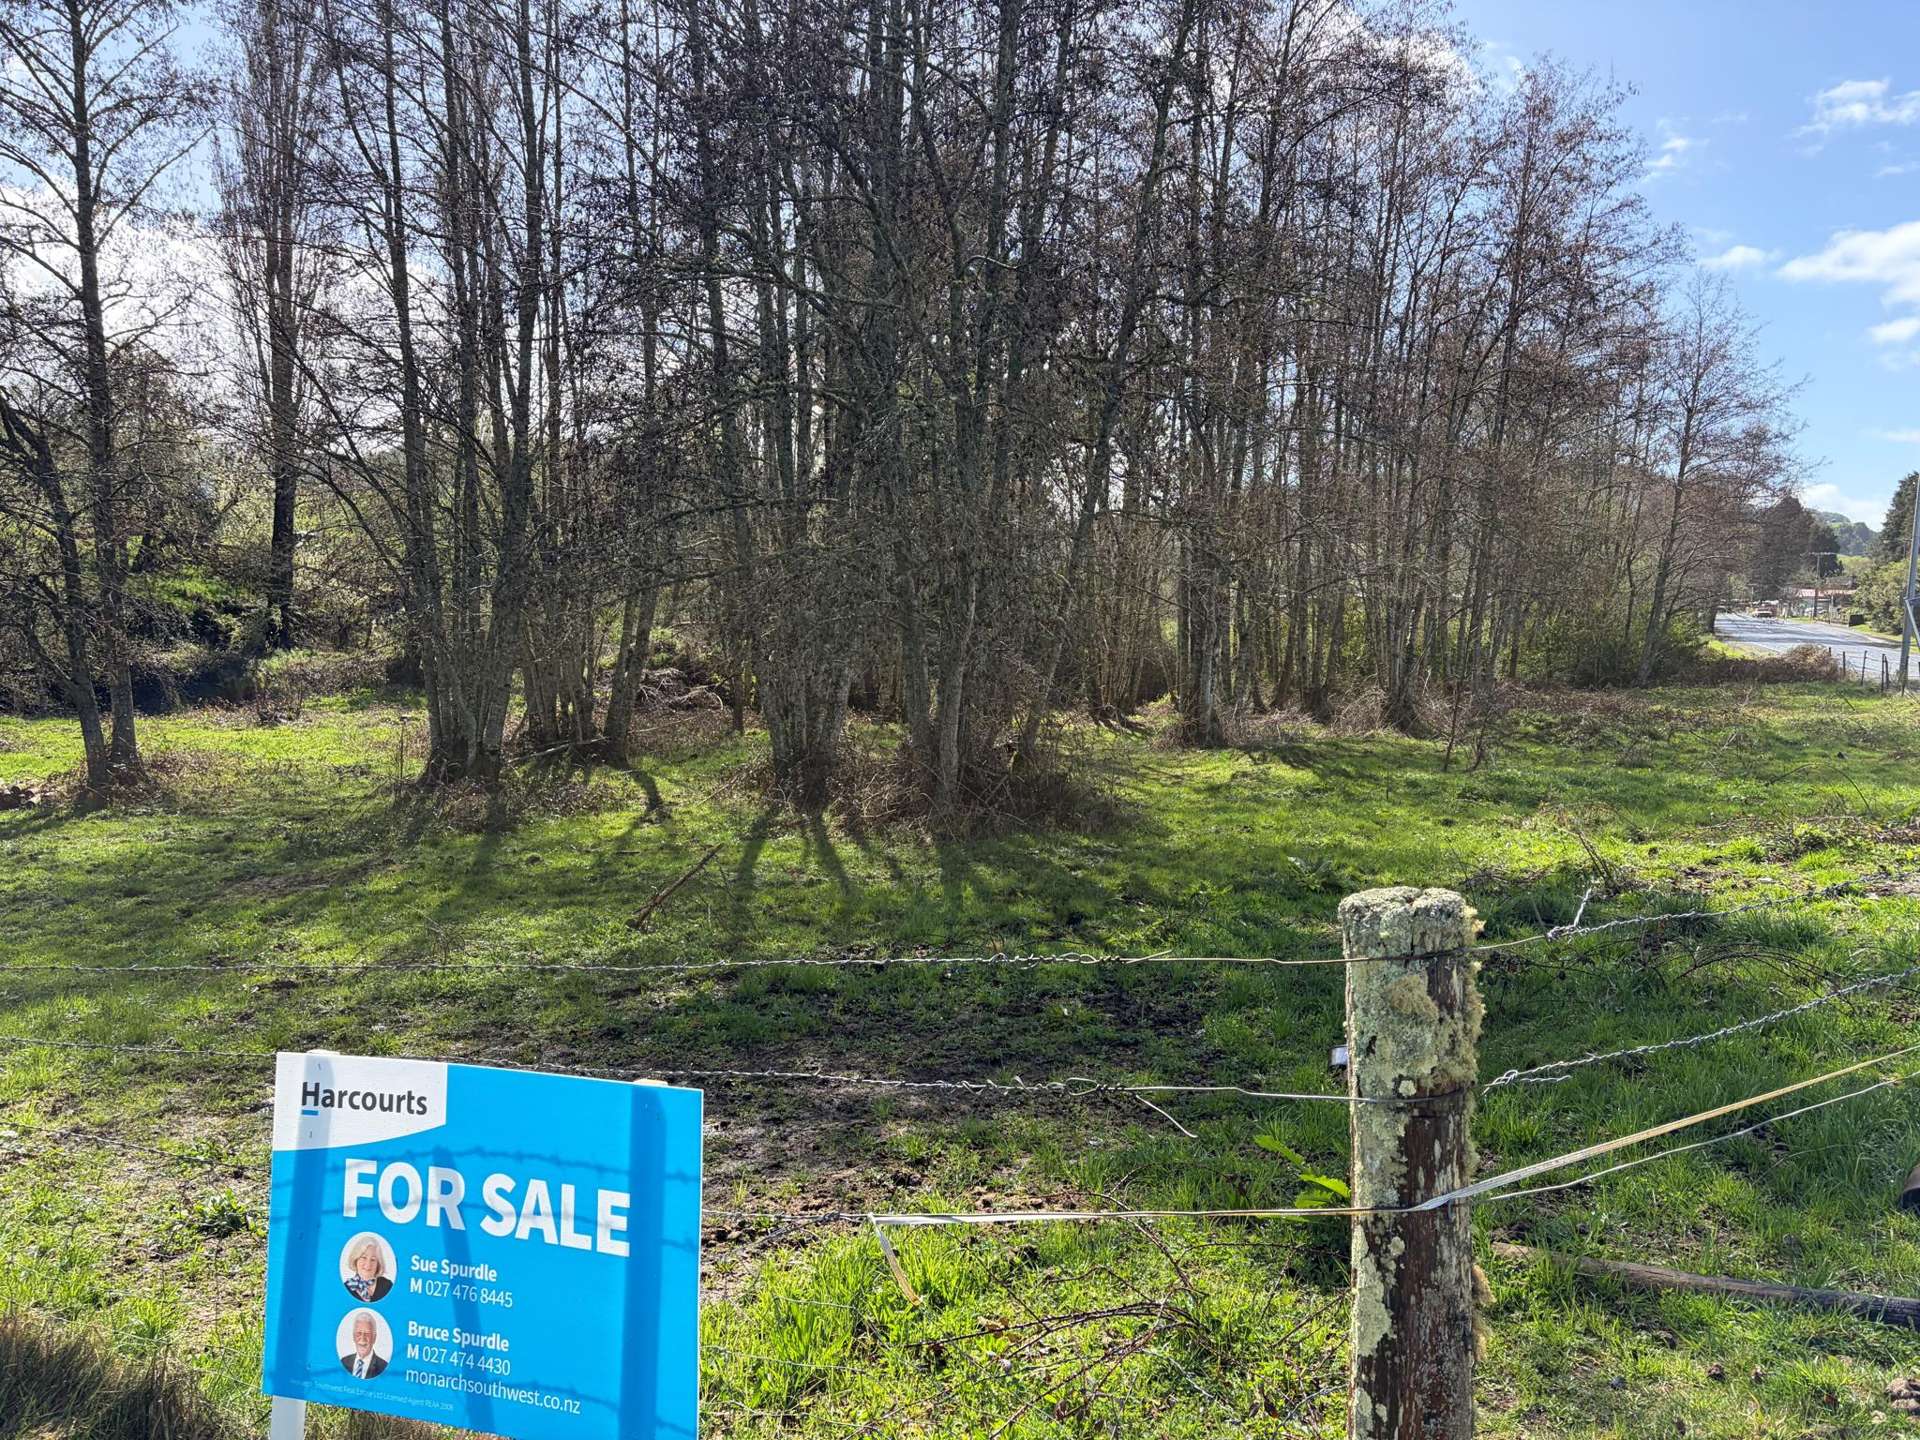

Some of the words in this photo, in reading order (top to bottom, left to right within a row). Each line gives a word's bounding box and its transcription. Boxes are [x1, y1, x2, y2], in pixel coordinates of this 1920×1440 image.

[302, 1082, 426, 1115] Harcourts
[343, 1159, 465, 1231] FOR
[480, 1174, 630, 1257] SALE
[411, 1255, 437, 1272] Sue
[440, 1259, 497, 1282] Spurdle
[410, 1278, 422, 1293] M
[426, 1280, 449, 1296] 027
[453, 1285, 476, 1301] 476
[481, 1289, 512, 1307] 8445
[409, 1321, 449, 1341] Bruce
[453, 1328, 509, 1351] Spurdle
[408, 1344, 419, 1359] M
[423, 1347, 446, 1362] 027
[450, 1352, 474, 1368] 474
[478, 1357, 510, 1375] 4430
[407, 1368, 579, 1413] monarchsouthwest.co.nz
